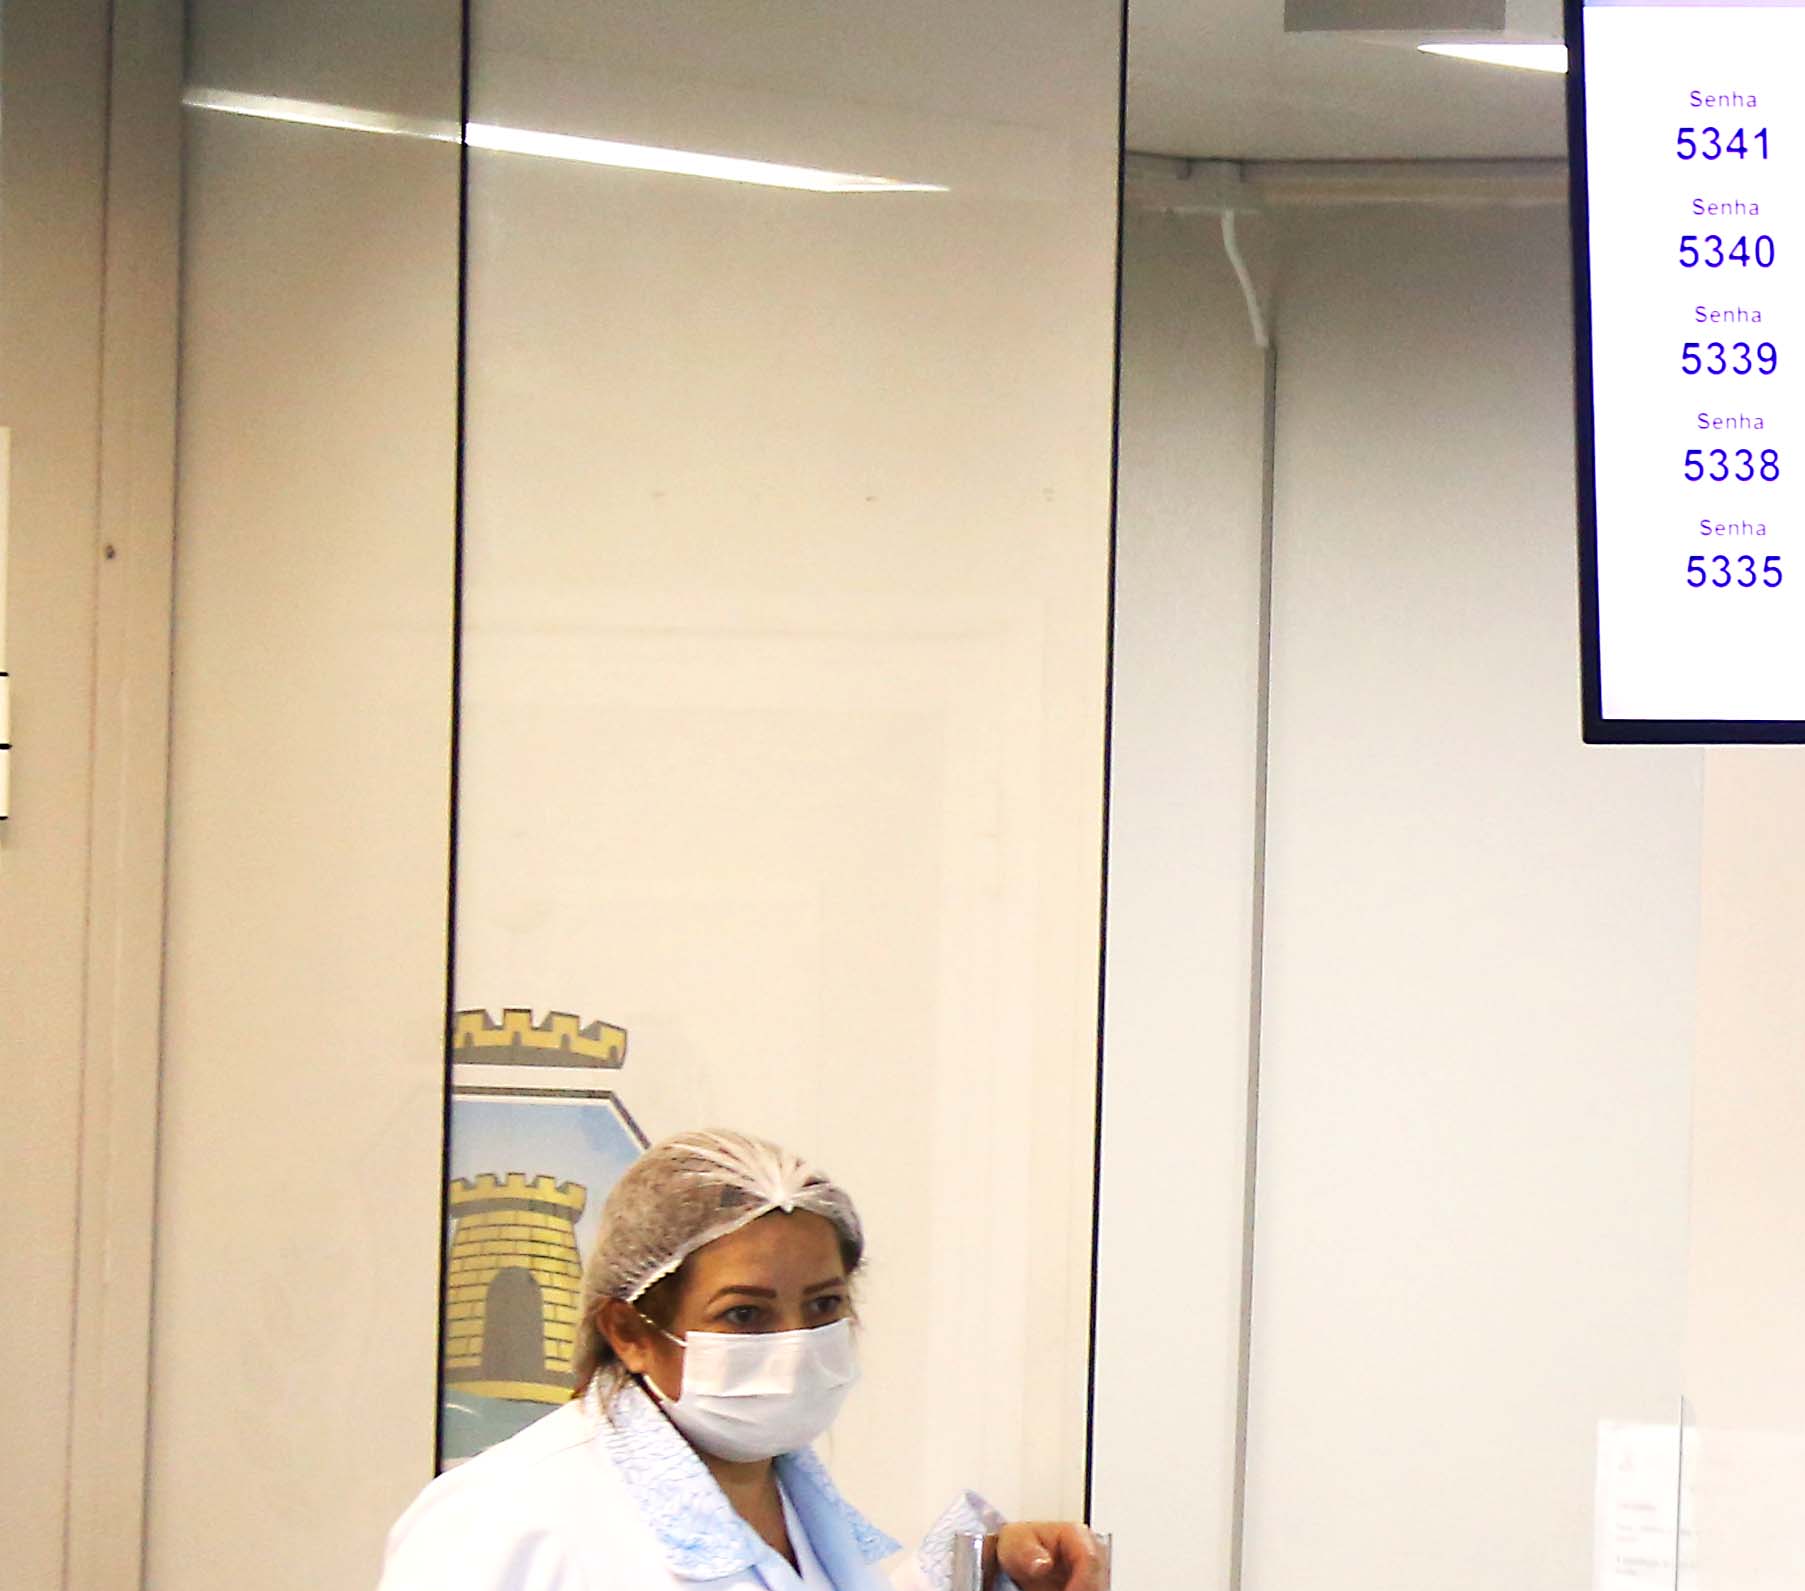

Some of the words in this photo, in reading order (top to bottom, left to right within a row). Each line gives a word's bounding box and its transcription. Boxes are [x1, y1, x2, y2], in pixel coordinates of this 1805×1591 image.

[1690, 90, 1757, 108] Senha
[1677, 127, 1768, 160] 5341
[1692, 198, 1759, 215] Senha
[1679, 234, 1775, 268] 5340
[1695, 306, 1761, 323] Senha
[1681, 342, 1777, 375] 5339
[1697, 413, 1764, 430] Senha
[1684, 449, 1780, 482] 5338
[1700, 519, 1766, 536] Senha
[1686, 555, 1783, 588] 5335
